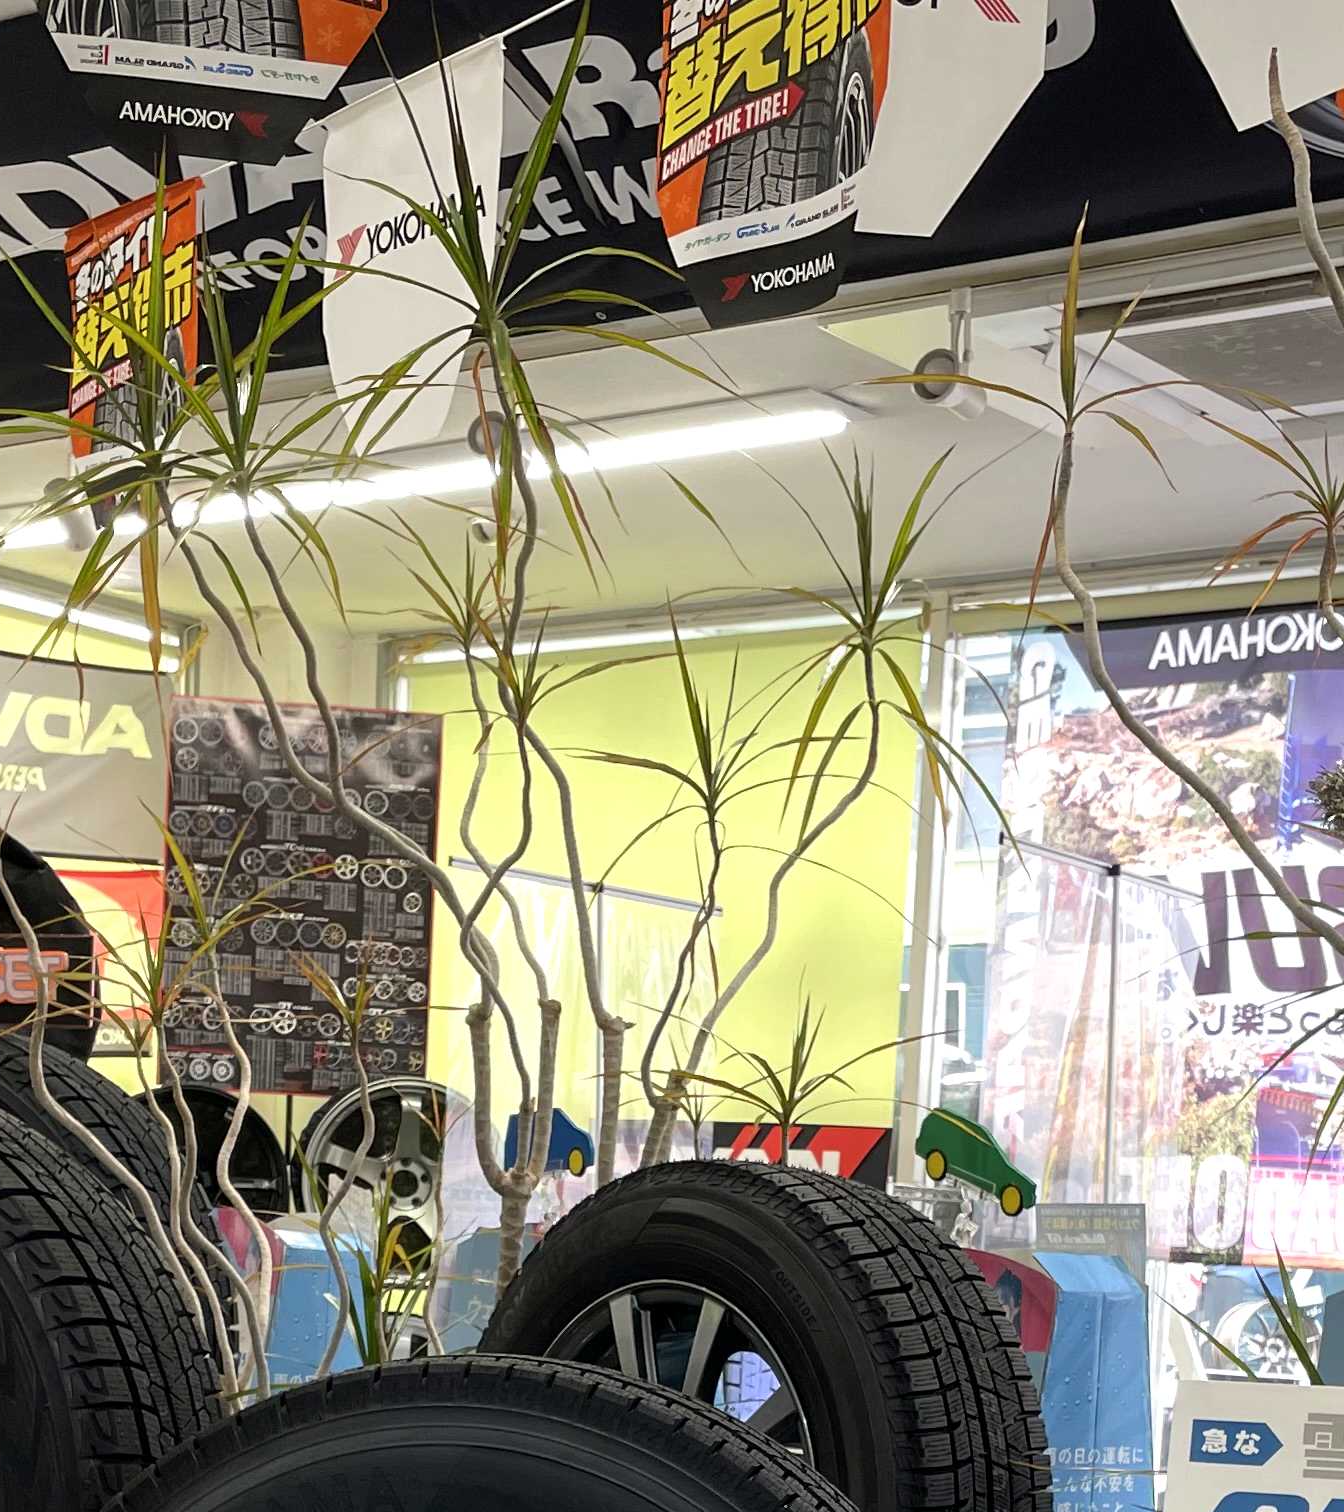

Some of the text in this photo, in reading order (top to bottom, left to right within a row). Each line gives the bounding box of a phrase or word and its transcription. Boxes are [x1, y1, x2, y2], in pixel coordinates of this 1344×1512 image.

[662, 89, 789, 181] CHANGE THE TIRE!
[366, 184, 488, 261] YOKOHAA
[751, 252, 836, 293] YOKOHAMA
[1200, 1428, 1262, 1456] 急な
